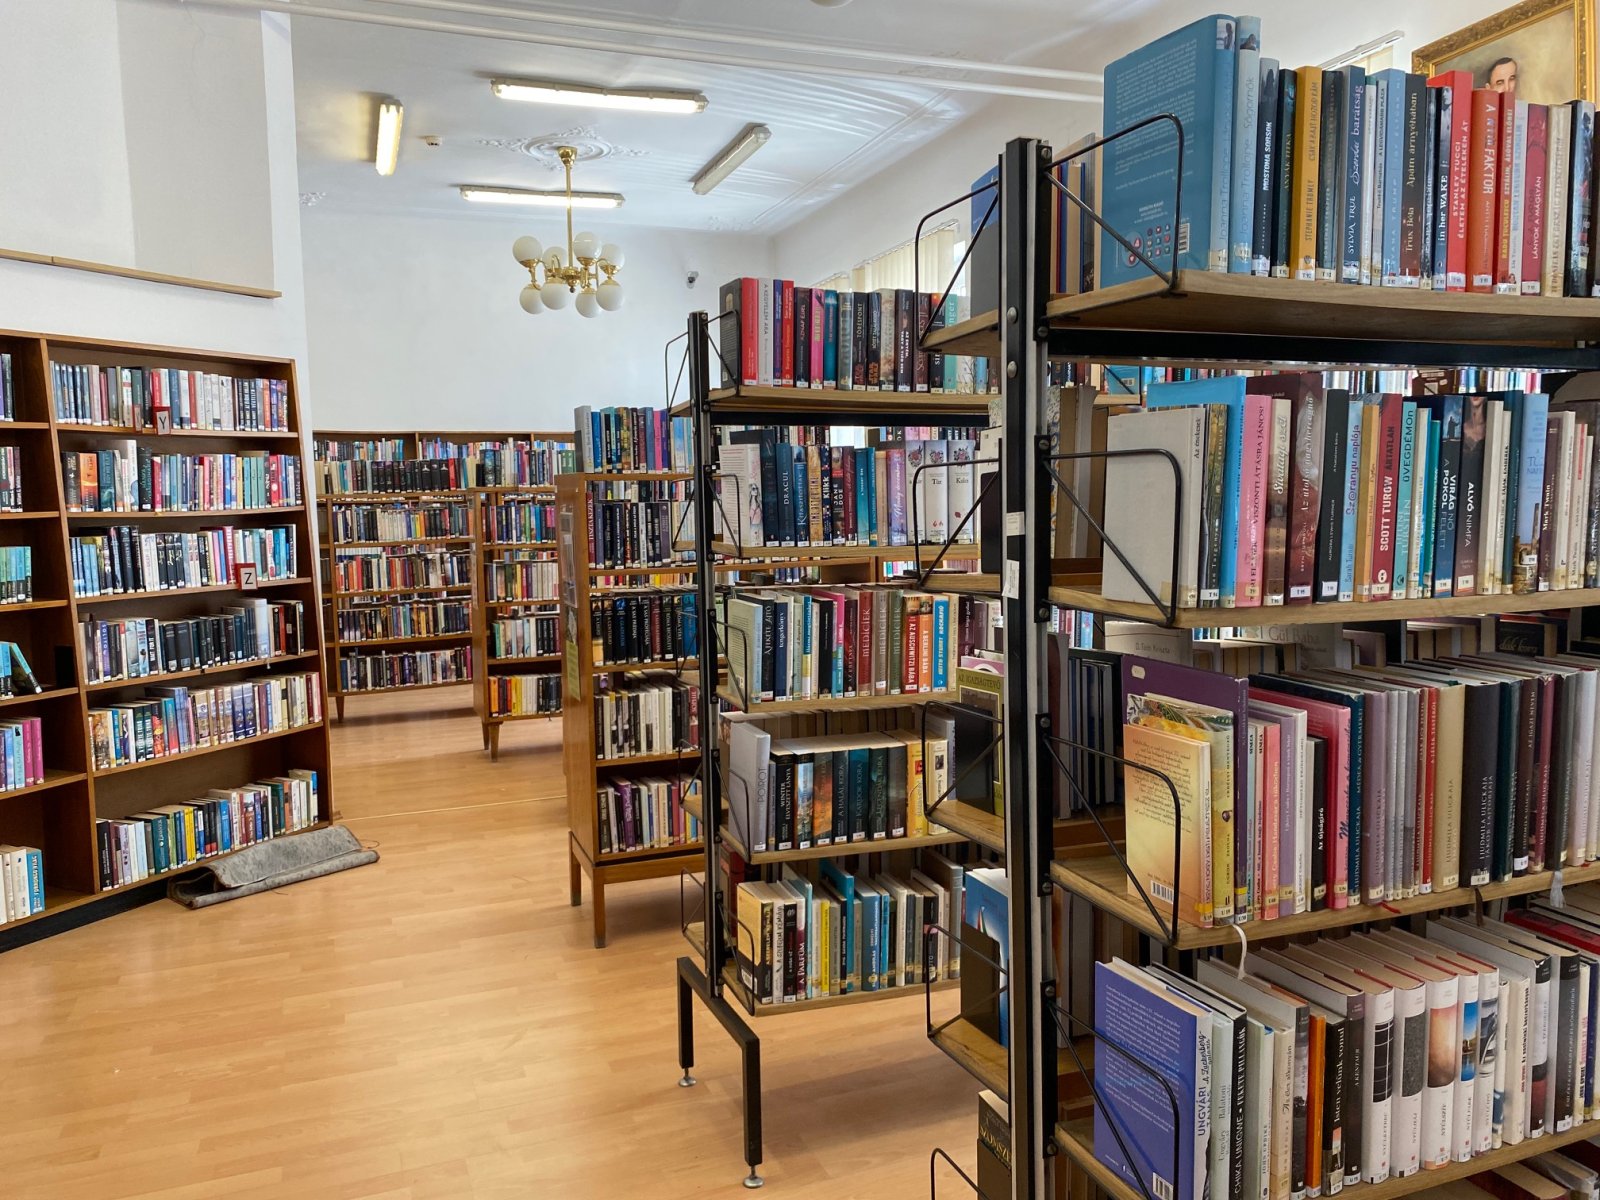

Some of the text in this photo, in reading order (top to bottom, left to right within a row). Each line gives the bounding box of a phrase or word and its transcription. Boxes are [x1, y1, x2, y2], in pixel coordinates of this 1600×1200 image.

[1264, 121, 1273, 152] SORSOK
[1405, 92, 1418, 252] Trux Béla Apám árnyékában
[1457, 120, 1468, 239] ÉLETEM AZ ÉTELEKEN ÁT
[1239, 192, 1250, 236] Joanna
[1438, 175, 1448, 241] in her WAKE
[1533, 176, 1542, 217] MÁGLYÁN
[1304, 206, 1314, 241] STEPHANIE
[1346, 195, 1357, 254] SYLVIA TRUE
[1532, 225, 1540, 259] LÁNYOK
[158, 416, 167, 430] Y
[1194, 449, 1201, 459] Az
[1350, 424, 1360, 458] naplója
[1253, 406, 1265, 524] VISZONTLÁTÁSRA JÁNOS!
[782, 471, 790, 505] DRACUL
[1381, 476, 1394, 514] TUROW
[1439, 459, 1450, 550] A POKOL FELETT
[1448, 474, 1457, 511] VIRÁG
[1300, 500, 1309, 513] Az
[1464, 481, 1474, 547] ALVÓ NIMFA
[1542, 510, 1550, 531] Mark
[1380, 516, 1390, 551] SCOTT
[243, 572, 254, 585] Z
[910, 623, 917, 631] AZ
[1268, 626, 1289, 641] Gül
[907, 667, 915, 683] BÁBA
[1527, 739, 1533, 748] AZ
[1479, 776, 1488, 859] LJUDMILA ULICKAJA
[1445, 821, 1453, 863] LJUDMILA
[797, 942, 805, 976] PARFÜM
[1236, 1072, 1245, 1106] FEKETE
[1333, 1027, 1345, 1122] Isten velünk vonul
[1196, 1086, 1206, 1136] UNGVÁRI
[1218, 1084, 1227, 1161] Ungváry Balatoni
[1282, 1100, 1290, 1115] Az
[1235, 1114, 1244, 1159] UNIGWE
[1234, 1160, 1242, 1194] CHIKA
